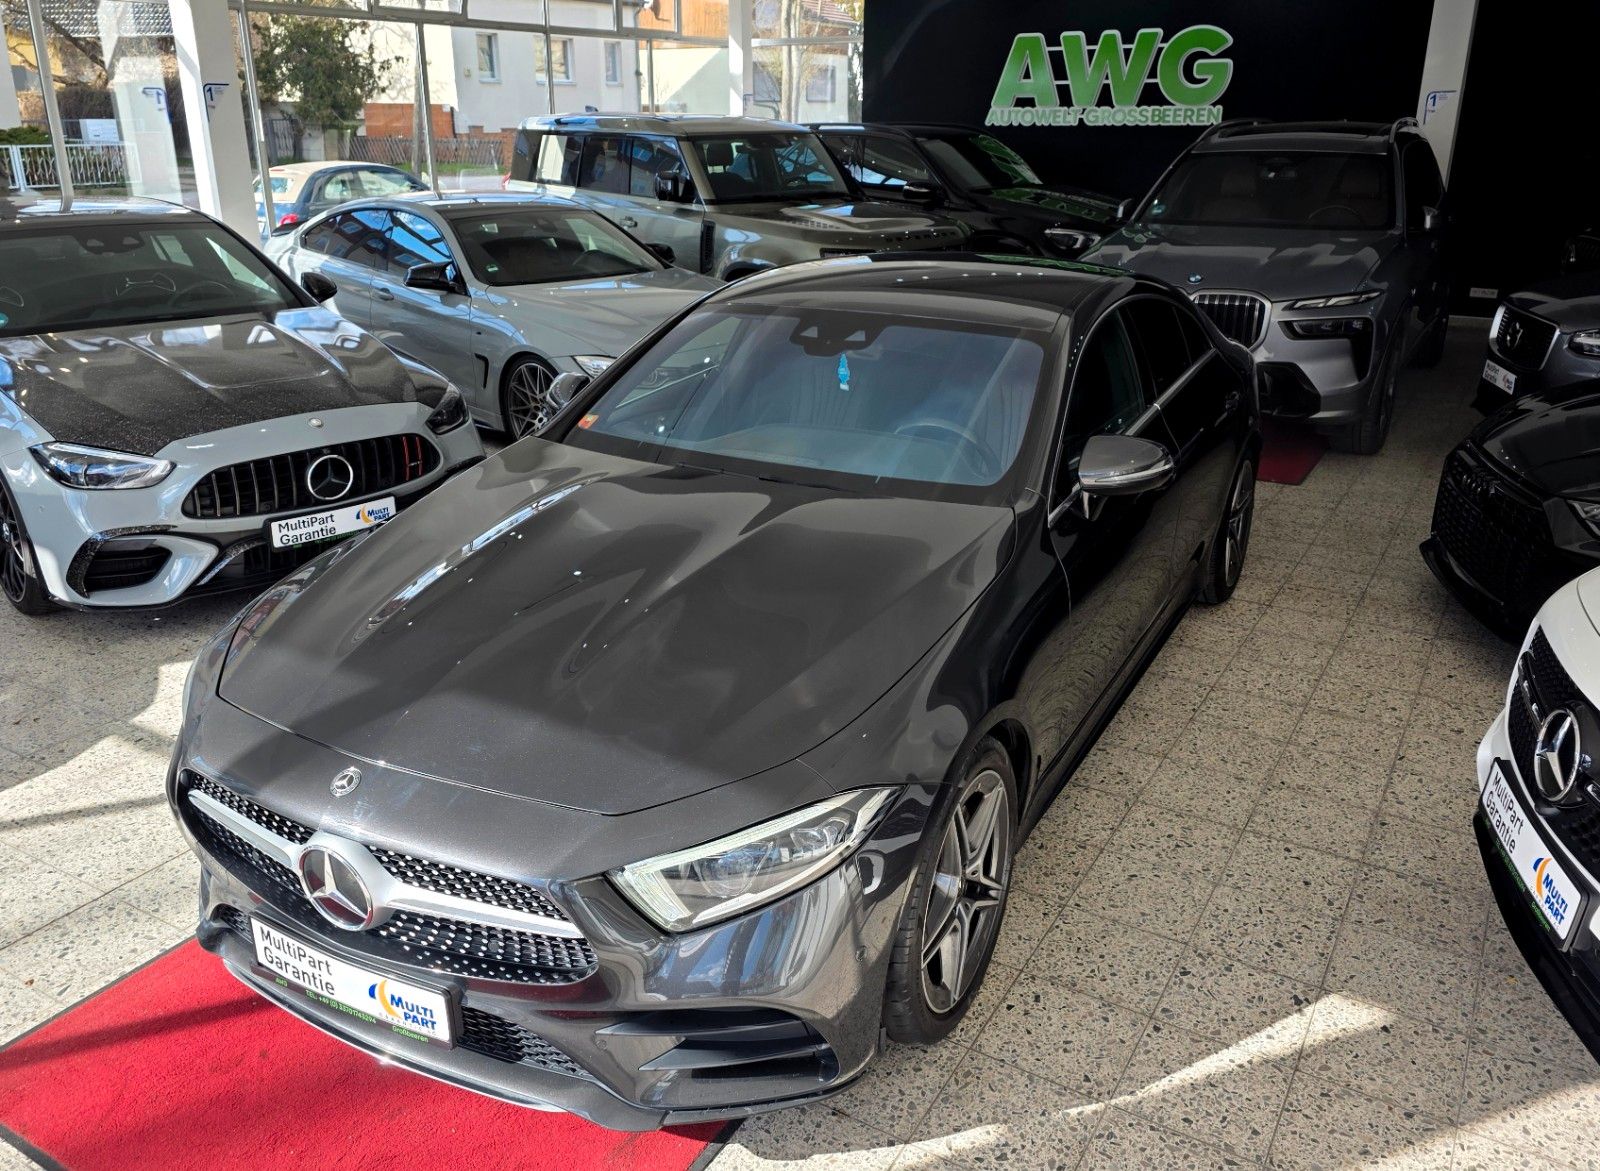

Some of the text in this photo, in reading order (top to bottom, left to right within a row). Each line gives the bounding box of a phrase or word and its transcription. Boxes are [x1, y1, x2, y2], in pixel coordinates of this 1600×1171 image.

[990, 24, 1234, 108] AWG
[986, 104, 1223, 126] AUTOWELT GROSSBEEREN
[278, 513, 335, 534] MultiPart
[280, 525, 336, 545] Garantie
[1493, 770, 1524, 836] MultiPart
[1486, 790, 1516, 855] Garantie
[1542, 872, 1569, 913] MULTI
[1544, 894, 1566, 926] PART
[260, 926, 333, 976] MultiPart
[263, 946, 335, 996] Garantie
[390, 993, 434, 1019] MULTI
[403, 1011, 437, 1030] PART
[392, 1025, 429, 1042] Großbeeren
